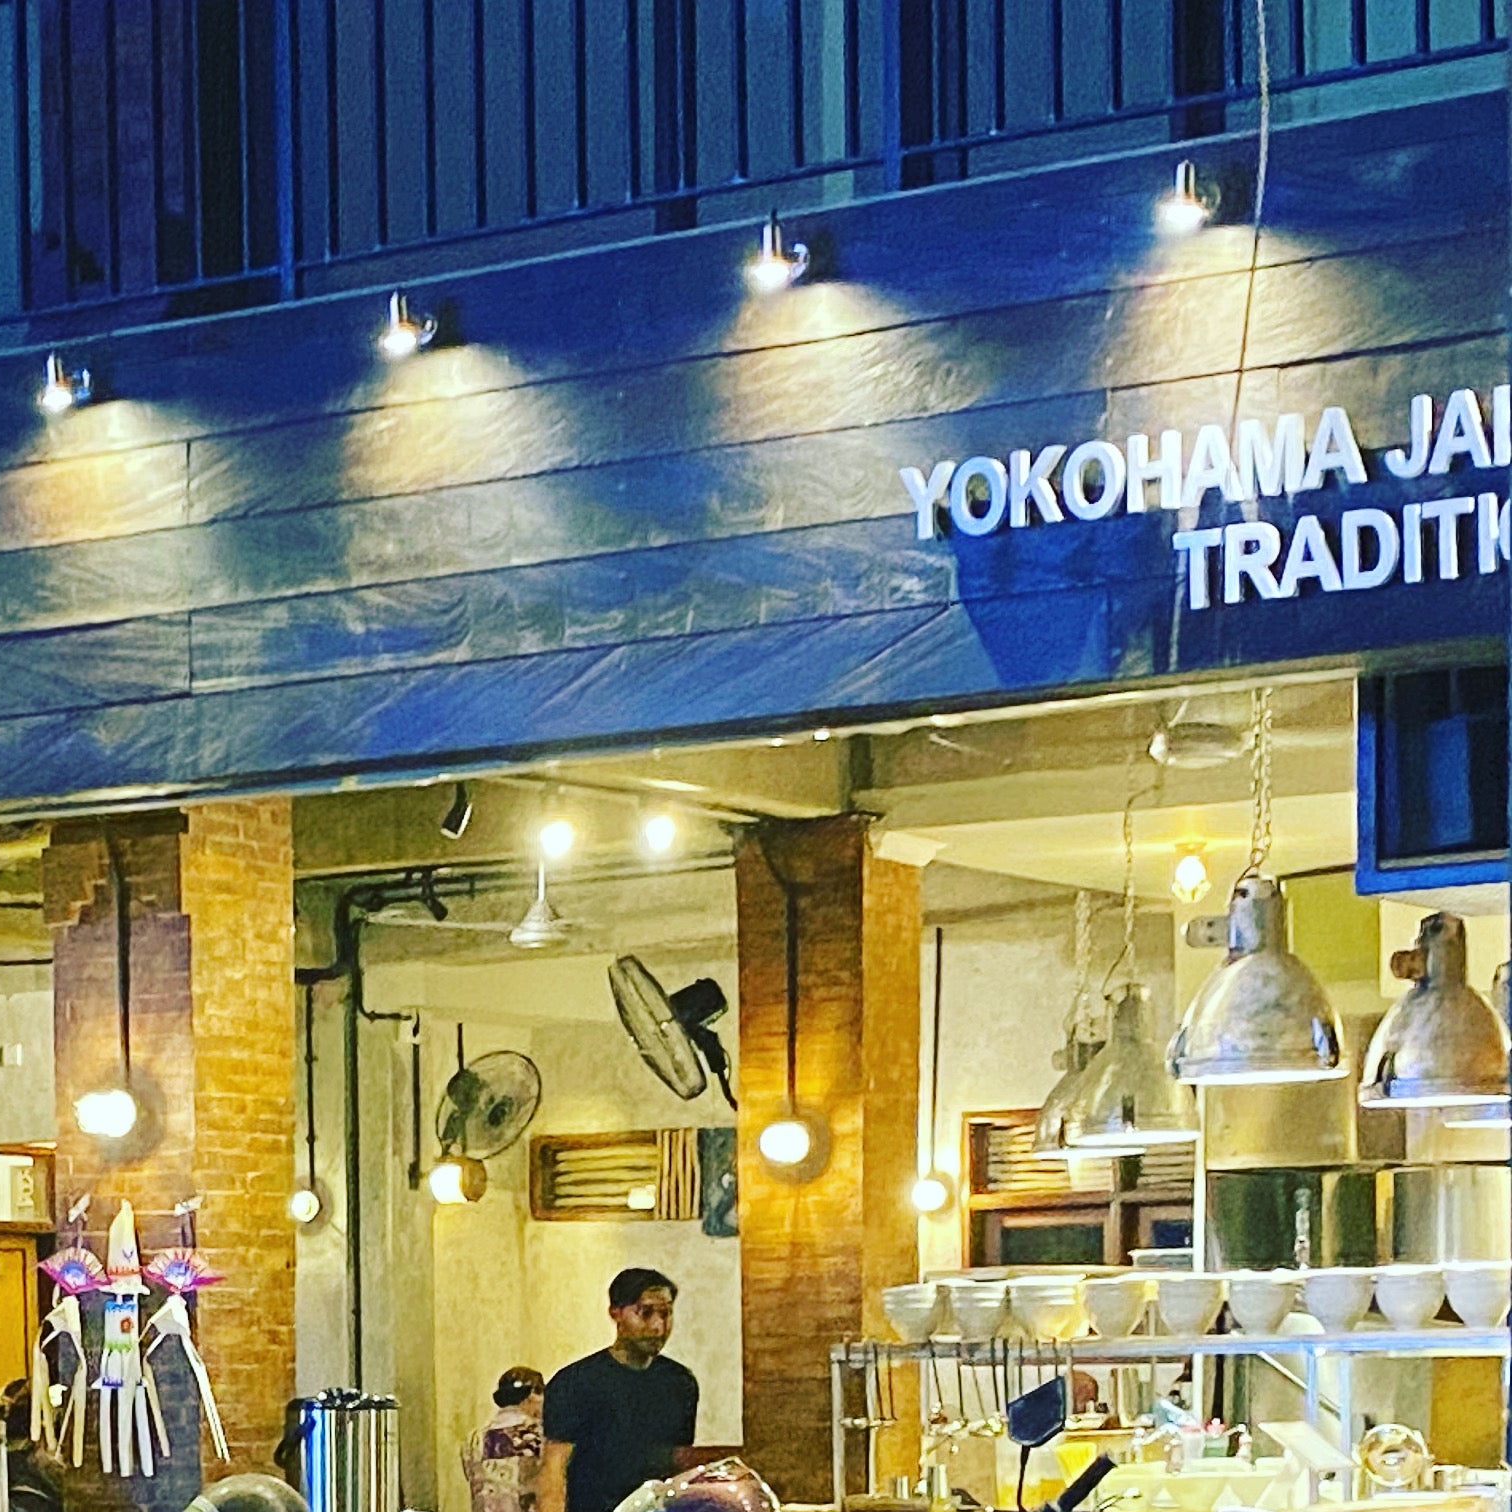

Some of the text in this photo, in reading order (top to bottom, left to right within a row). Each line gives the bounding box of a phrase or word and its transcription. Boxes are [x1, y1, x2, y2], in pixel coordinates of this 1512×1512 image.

[899, 384, 1511, 540] YOKOHAMA JA
[1172, 491, 1511, 610] TRADITI
